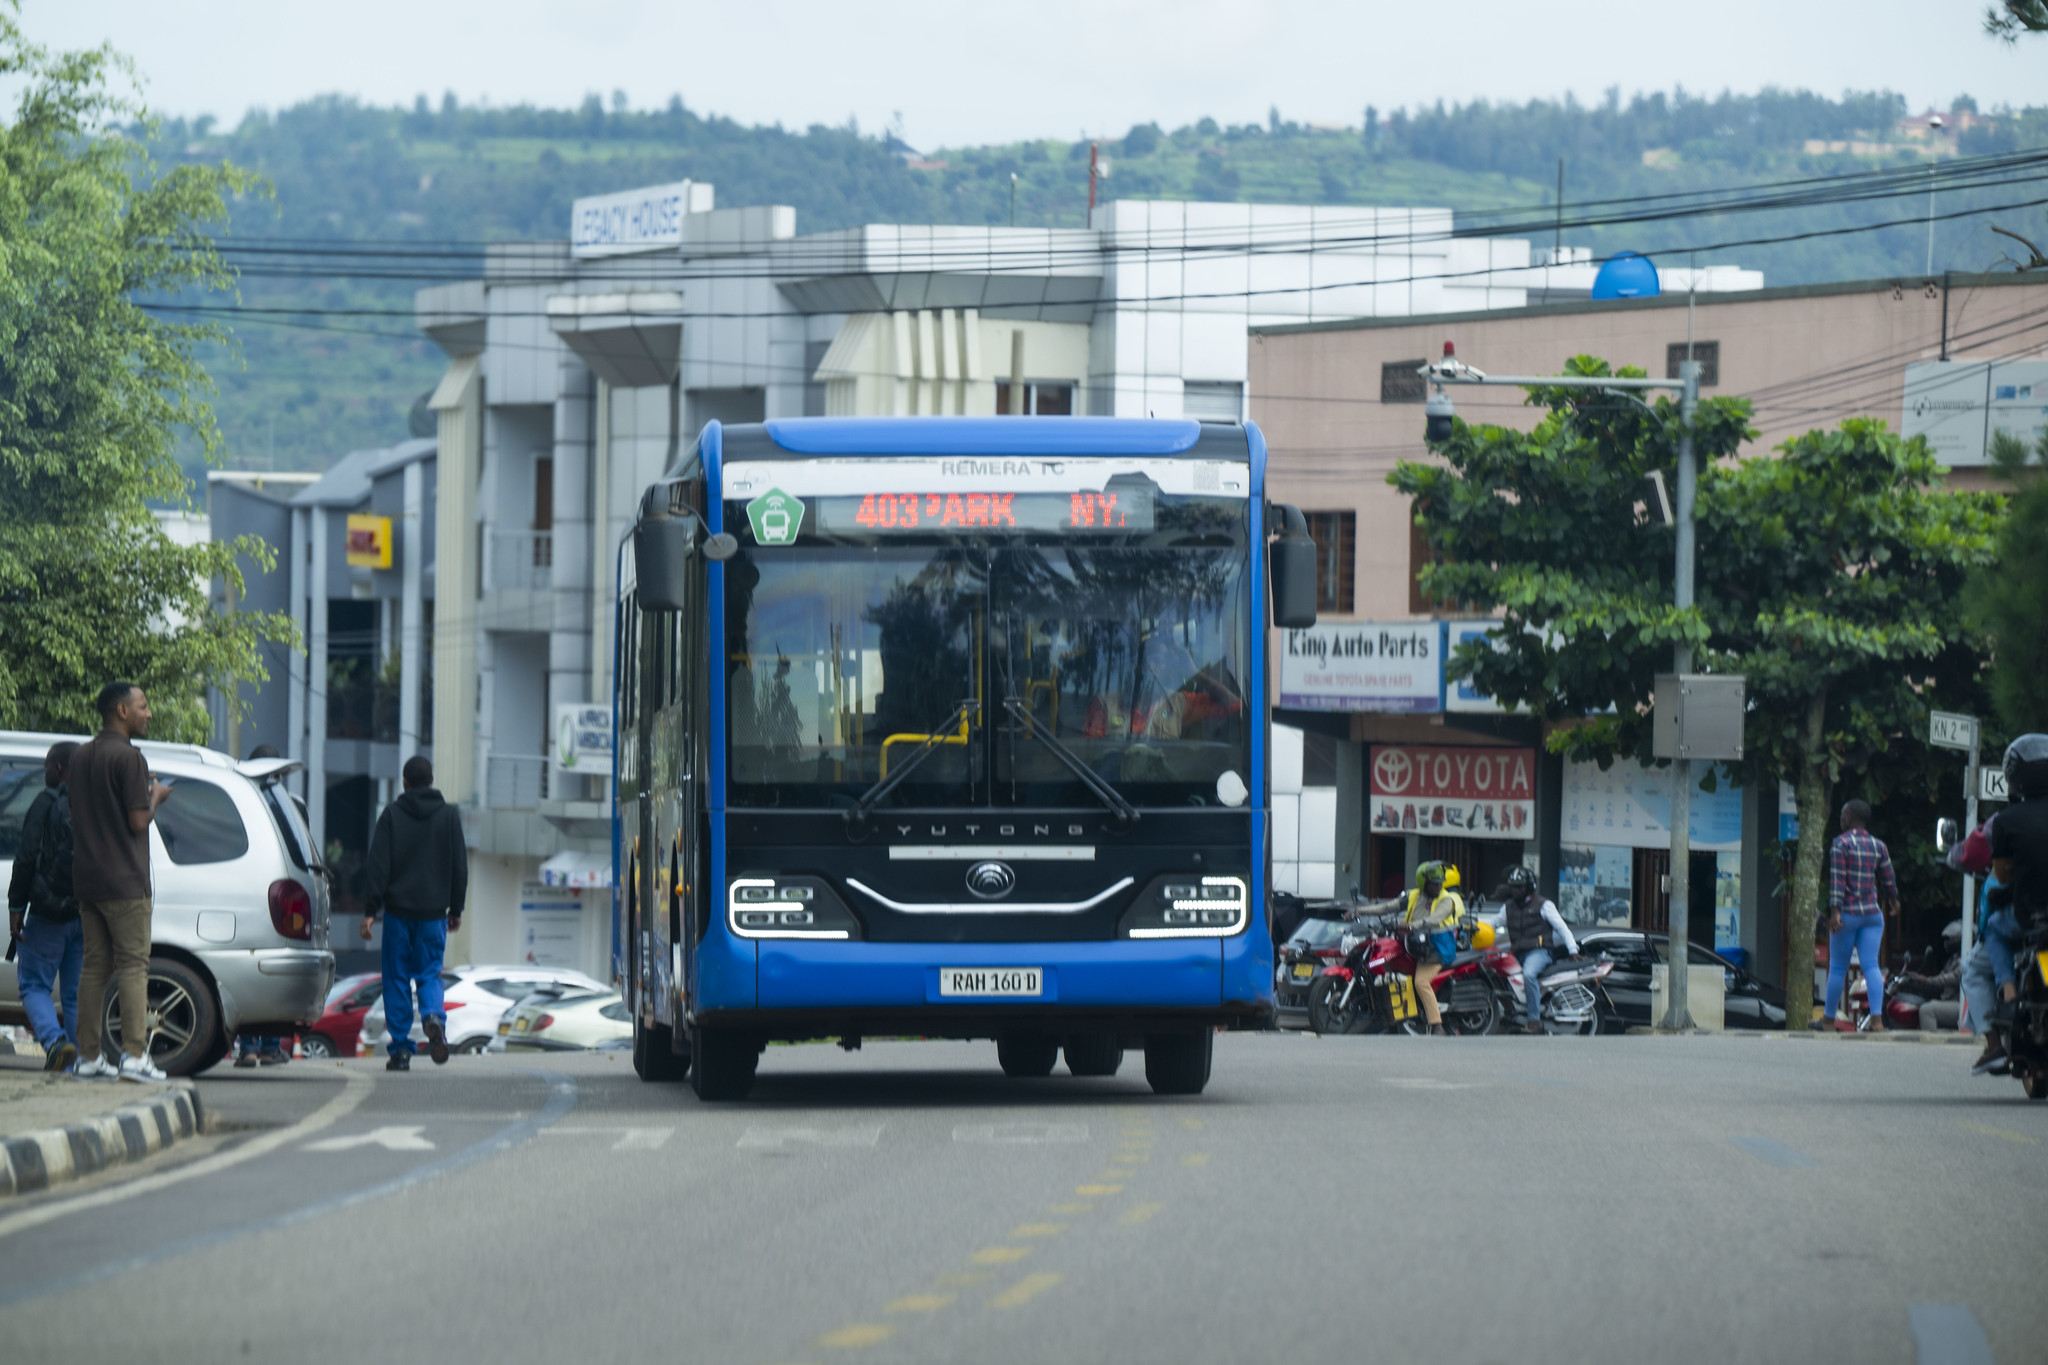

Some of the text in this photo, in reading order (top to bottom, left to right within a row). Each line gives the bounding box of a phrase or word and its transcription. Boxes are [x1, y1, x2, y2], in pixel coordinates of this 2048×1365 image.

[576, 197, 680, 247] LEGACY HOUSE
[941, 460, 1031, 475] REMERA
[856, 493, 918, 528] 403
[1289, 631, 1428, 669] King Auto Parts
[1934, 718, 1947, 739] KN
[1950, 721, 1957, 741] 2
[1416, 753, 1528, 791] TOYOTA
[1991, 773, 2004, 793] K
[897, 824, 1083, 836] YUTONG
[953, 973, 1036, 992] RAH 160 D
